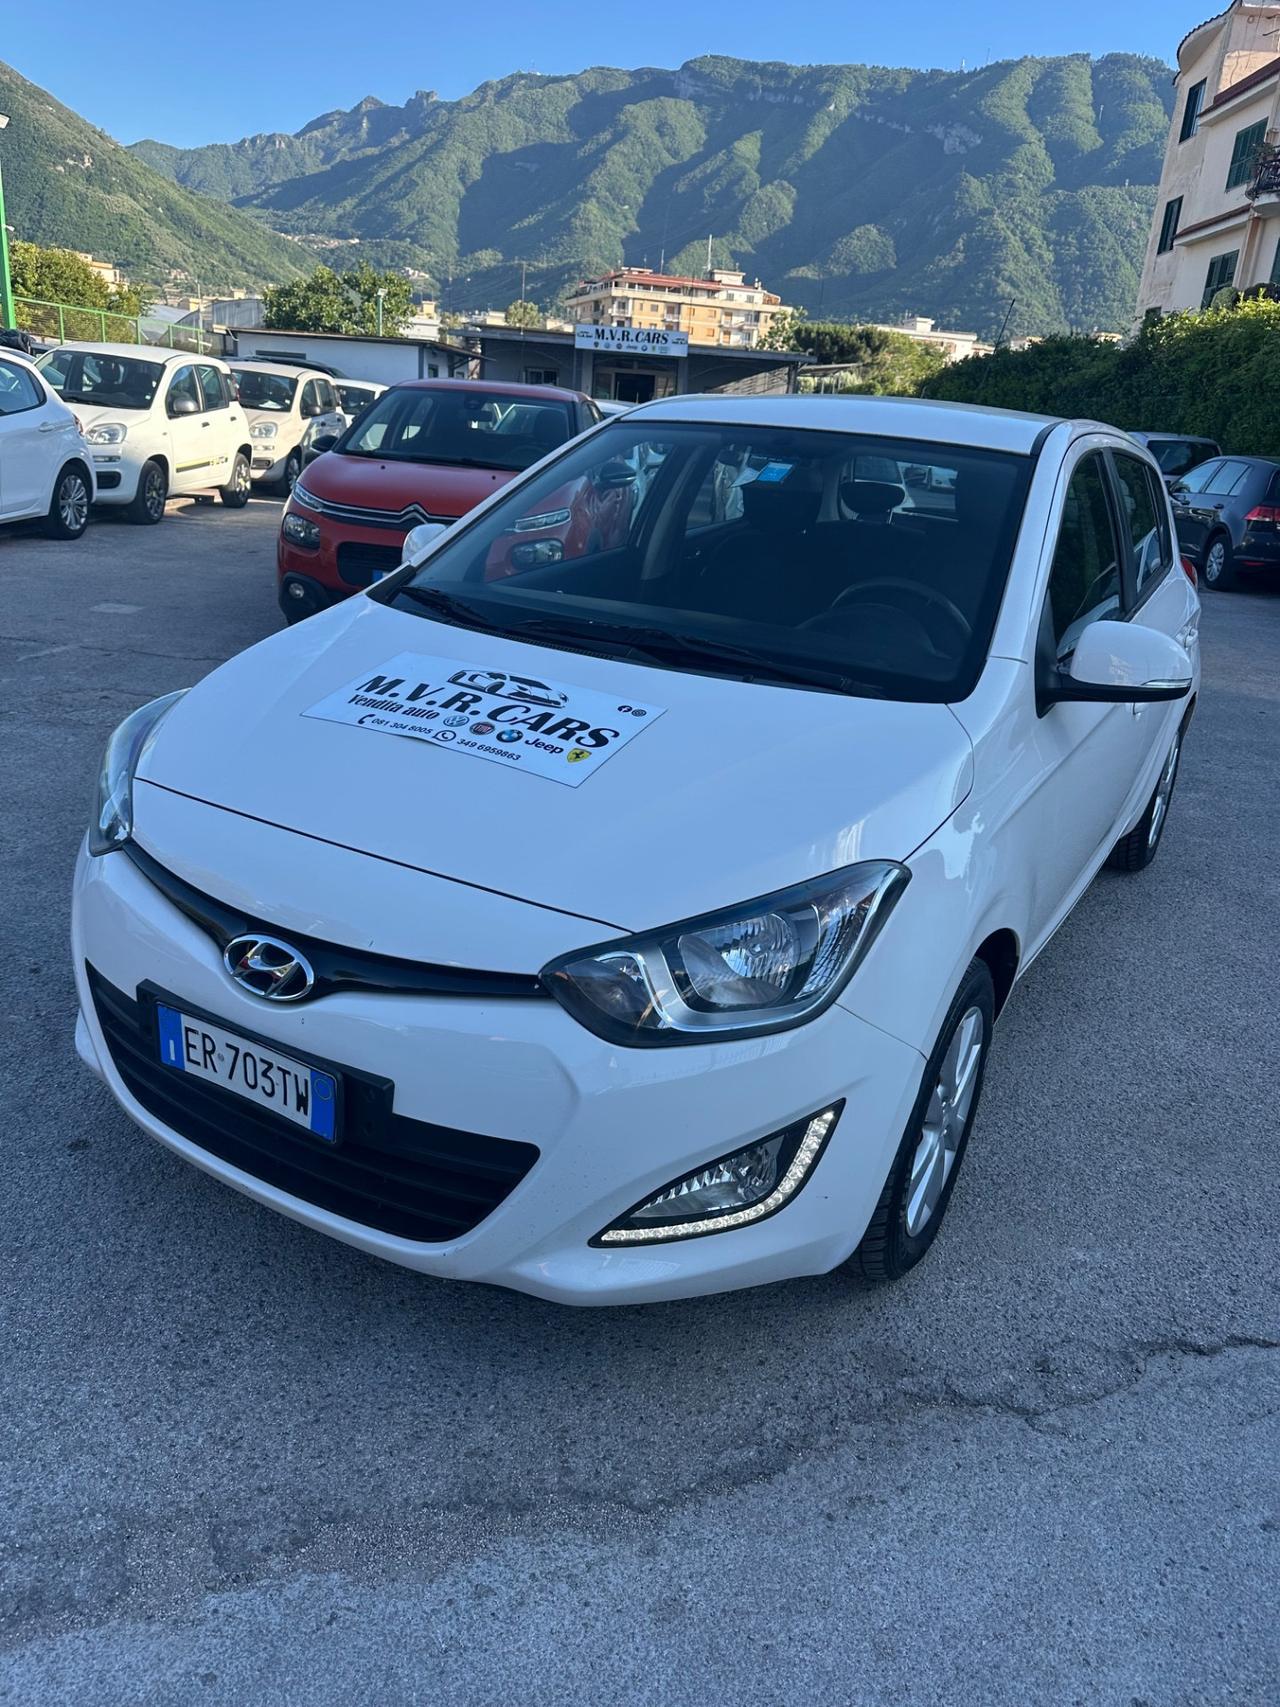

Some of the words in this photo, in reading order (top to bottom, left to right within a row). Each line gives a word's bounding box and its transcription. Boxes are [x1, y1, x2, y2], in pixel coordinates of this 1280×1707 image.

[348, 694, 404, 713] Vendita
[402, 706, 440, 720] auto
[457, 738, 477, 748] 349
[477, 744, 521, 760] 6959863
[525, 738, 564, 754] Jeep
